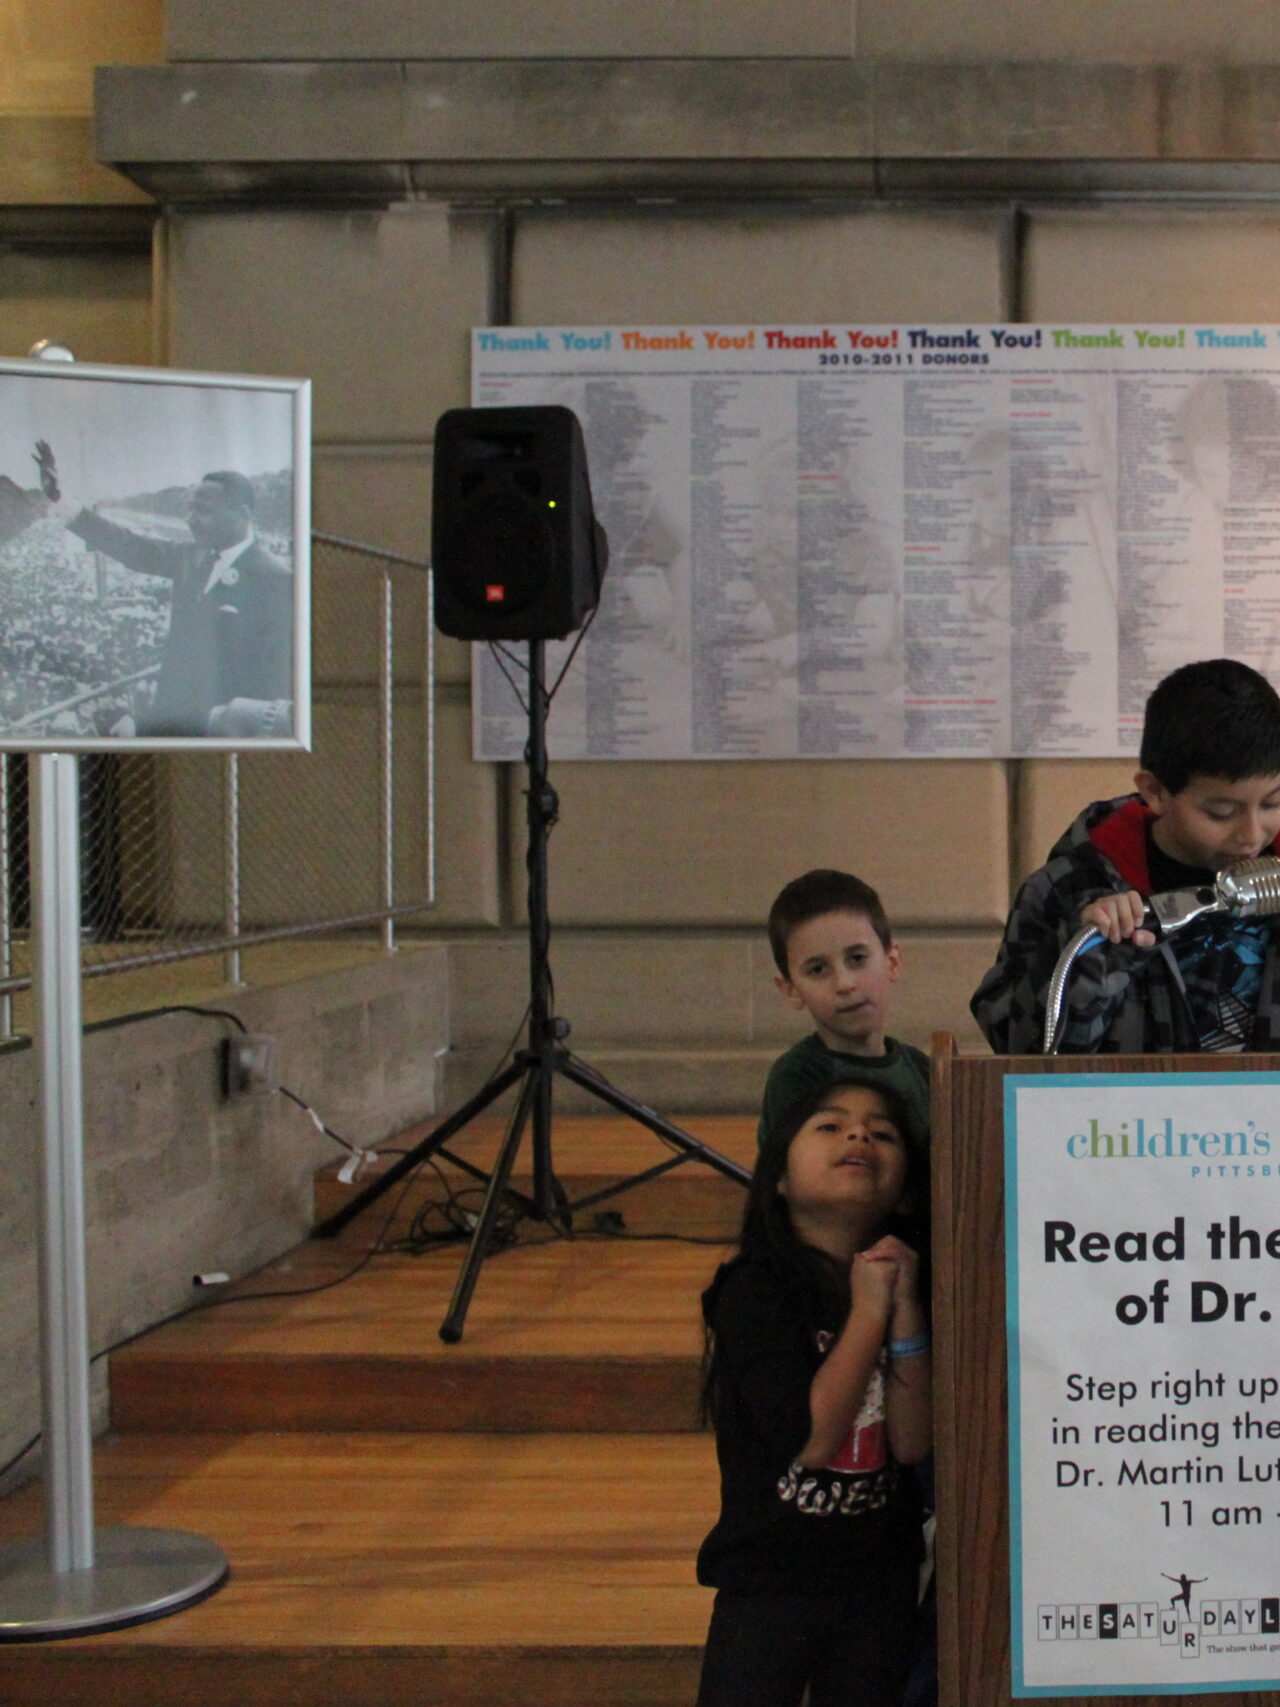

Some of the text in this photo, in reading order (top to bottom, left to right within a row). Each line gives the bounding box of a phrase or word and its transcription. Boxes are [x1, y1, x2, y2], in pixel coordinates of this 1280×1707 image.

[478, 332, 549, 351] Thank
[561, 331, 611, 350] You!
[621, 331, 693, 350] Thank
[704, 331, 755, 350] You!
[764, 330, 836, 349] Thank
[847, 330, 898, 348] You!
[908, 329, 980, 348] Thank
[991, 329, 1041, 348] You!
[1051, 329, 1123, 348] Thank
[1134, 330, 1185, 348] You!
[1194, 329, 1266, 348] Thank
[819, 353, 989, 365] 2010-2011 DONORS
[1067, 1118, 1270, 1158] children's
[1045, 1217, 1185, 1263] Read
[1116, 1279, 1169, 1325] of
[1191, 1281, 1271, 1322] Dr.
[1067, 1374, 1137, 1407] Step
[1152, 1370, 1225, 1405] right
[1239, 1378, 1278, 1403] up
[1052, 1418, 1079, 1444] in
[1095, 1414, 1219, 1448] reading
[1057, 1461, 1103, 1487] Dr.
[1118, 1457, 1223, 1485] Martin
[1161, 1500, 1192, 1527] 11
[1212, 1507, 1261, 1526] am
[1207, 1645, 1223, 1653] The
[1249, 1644, 1267, 1652] that
